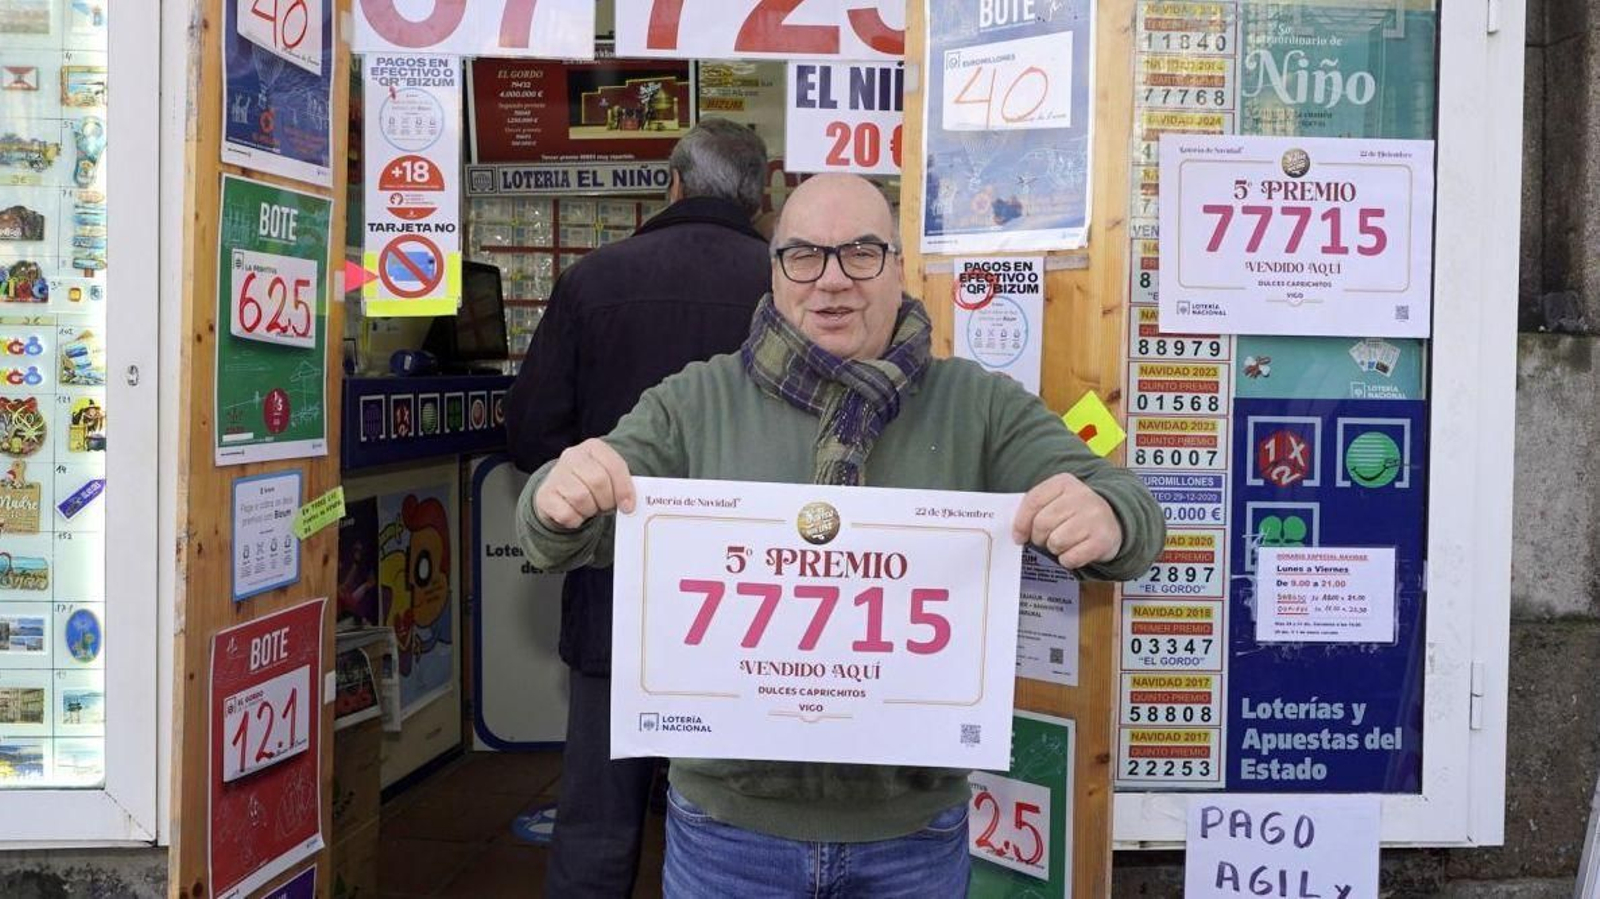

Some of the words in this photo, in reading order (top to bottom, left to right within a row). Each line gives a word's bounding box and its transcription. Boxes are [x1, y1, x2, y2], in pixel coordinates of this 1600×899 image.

[1147, 33, 1226, 51] 11840
[376, 58, 426, 67] PAGOS
[429, 59, 448, 67] EN
[371, 67, 441, 77] EFECTIVO
[443, 68, 454, 77] O
[498, 70, 508, 79] EL
[511, 70, 544, 79] GORDO
[1242, 49, 1376, 109] Niño
[406, 78, 455, 87] BIZUM
[796, 65, 838, 109] EL
[954, 66, 1049, 130] 40
[1144, 88, 1225, 106] 77768
[825, 121, 880, 167] 20
[391, 161, 431, 183] +18
[502, 170, 571, 190] LOTERIA
[577, 170, 604, 188] EL
[612, 165, 669, 188] NIÑO
[1261, 180, 1356, 202] PREMIO
[259, 202, 299, 241] BOTE
[368, 223, 432, 233] TARJETA
[435, 223, 456, 233] NO
[1202, 204, 1388, 257] 77715
[964, 262, 1011, 272] PAGOS
[1014, 262, 1033, 271] EN
[1246, 261, 1304, 274] VENDIDO
[960, 273, 1026, 283] EFECTIVO
[1028, 273, 1038, 283] O
[1258, 280, 1285, 288] DULCES
[993, 284, 1039, 294] BIZUM
[1139, 339, 1220, 357] 88979
[1140, 365, 1190, 376] NAVIDAD
[1192, 366, 1218, 377] 2023
[1179, 383, 1217, 392] PREMIO
[1137, 394, 1219, 412] 01568
[1138, 419, 1188, 430] NAVIDAD
[1190, 420, 1216, 431] 2023
[1136, 449, 1218, 466] 86007
[684, 498, 695, 507] de
[1172, 494, 1218, 502] 29-12-2020
[915, 507, 926, 516] 22
[928, 507, 940, 517] de
[940, 508, 994, 518] Diciembre
[1165, 507, 1206, 521] 0.000
[1211, 508, 1221, 520] €
[1189, 537, 1213, 546] 2020
[766, 547, 908, 580] PREMIO
[1134, 567, 1215, 583] 2897
[679, 578, 951, 656] 77715
[1133, 607, 1183, 618] NAVIDAD
[1186, 608, 1211, 618] 2018
[1134, 624, 1172, 633] PRIMER
[1174, 625, 1211, 634] PREMIO
[251, 627, 290, 671] BOTE
[1130, 638, 1213, 655] 03347
[740, 660, 826, 678] VENDIDO
[832, 661, 881, 682] AQUÍ
[1133, 677, 1182, 687] NAVIDAD
[1185, 678, 1210, 688] 2017
[758, 686, 797, 696] DULCES
[799, 688, 866, 698] CAPRICHITOS
[1171, 694, 1209, 703] PREMIO
[799, 704, 823, 712] VIGO
[1129, 706, 1212, 722] 58808
[1242, 697, 1345, 720] Loterías
[1352, 703, 1367, 725] y
[232, 687, 297, 773] 12.1
[662, 724, 712, 732] NACIONAL
[1132, 732, 1181, 742] NAVIDAD
[1183, 733, 1208, 743] 2017
[1242, 728, 1359, 755] Apuestas
[1365, 727, 1402, 749] del
[1170, 748, 1208, 757] PREMIO
[1127, 760, 1210, 777] 22253
[1241, 757, 1327, 780] Estado
[1200, 806, 1315, 849] PAGO
[1215, 861, 1320, 898] AGIL
